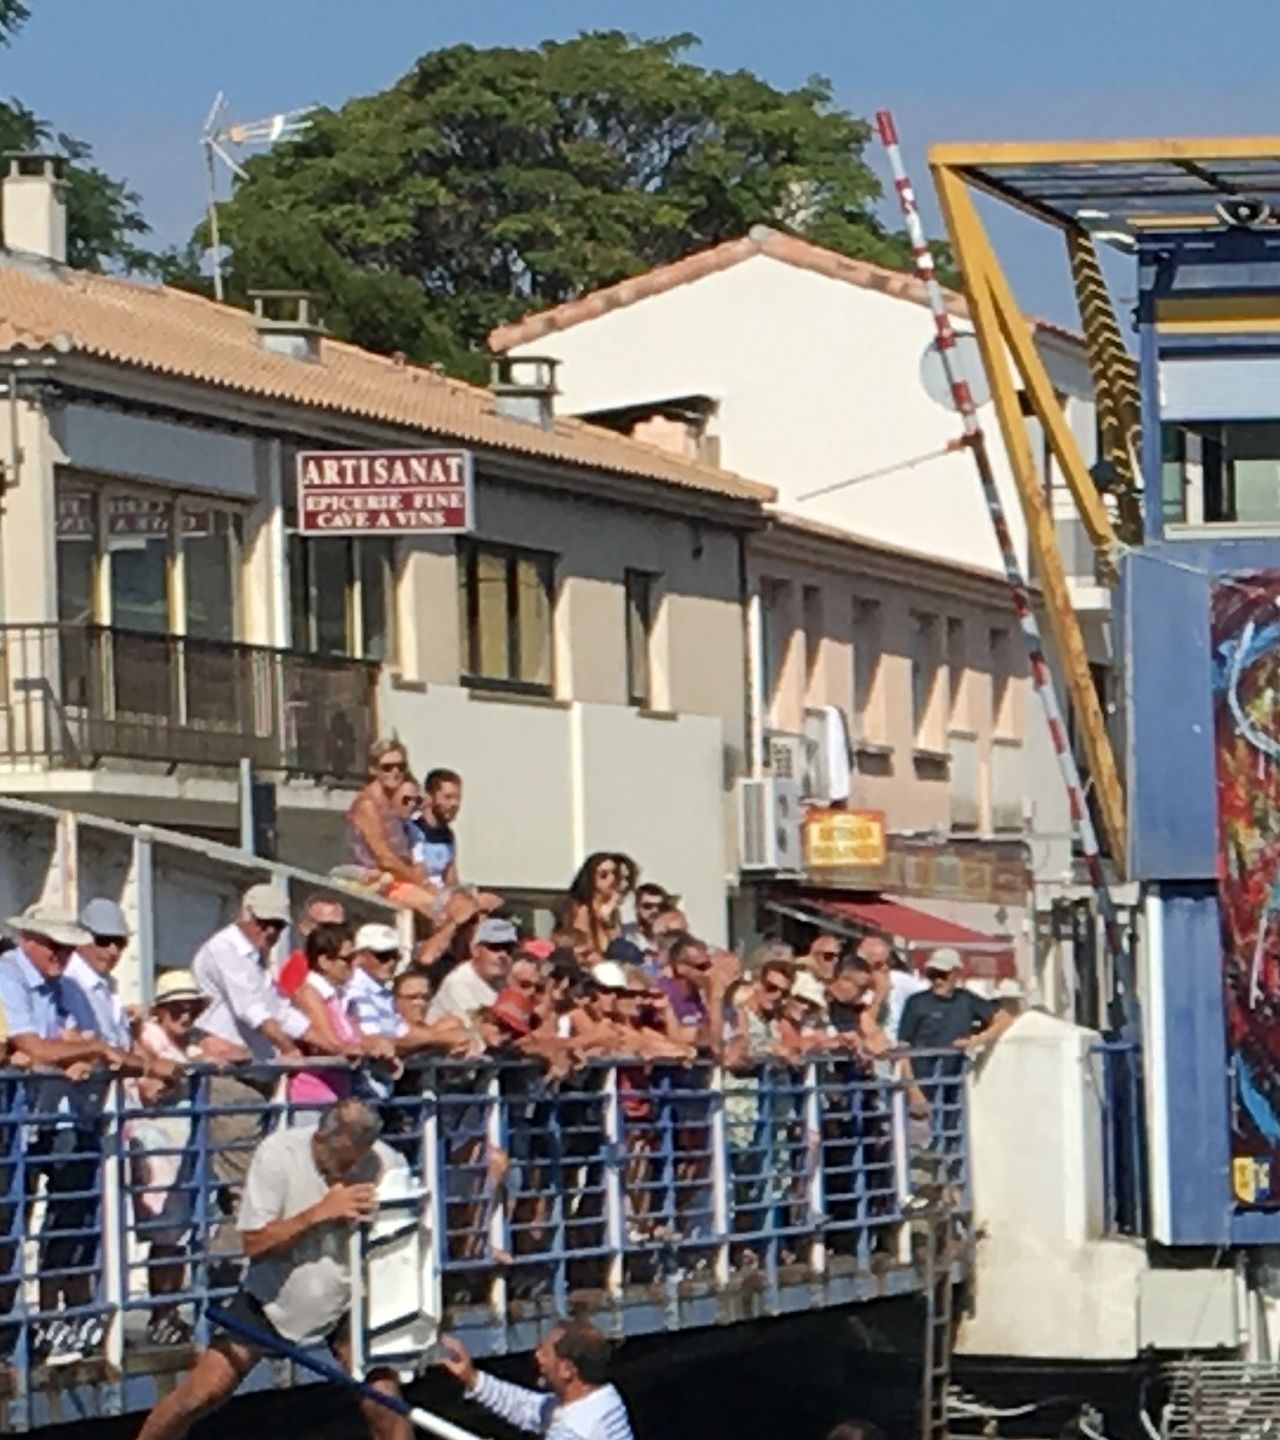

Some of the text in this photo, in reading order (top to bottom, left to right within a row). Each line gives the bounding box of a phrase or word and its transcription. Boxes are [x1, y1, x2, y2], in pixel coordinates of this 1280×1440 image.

[303, 456, 463, 485] ARTISANAT
[412, 492, 463, 509] FINE
[316, 512, 371, 528] CAVE
[396, 511, 447, 527] VINS
